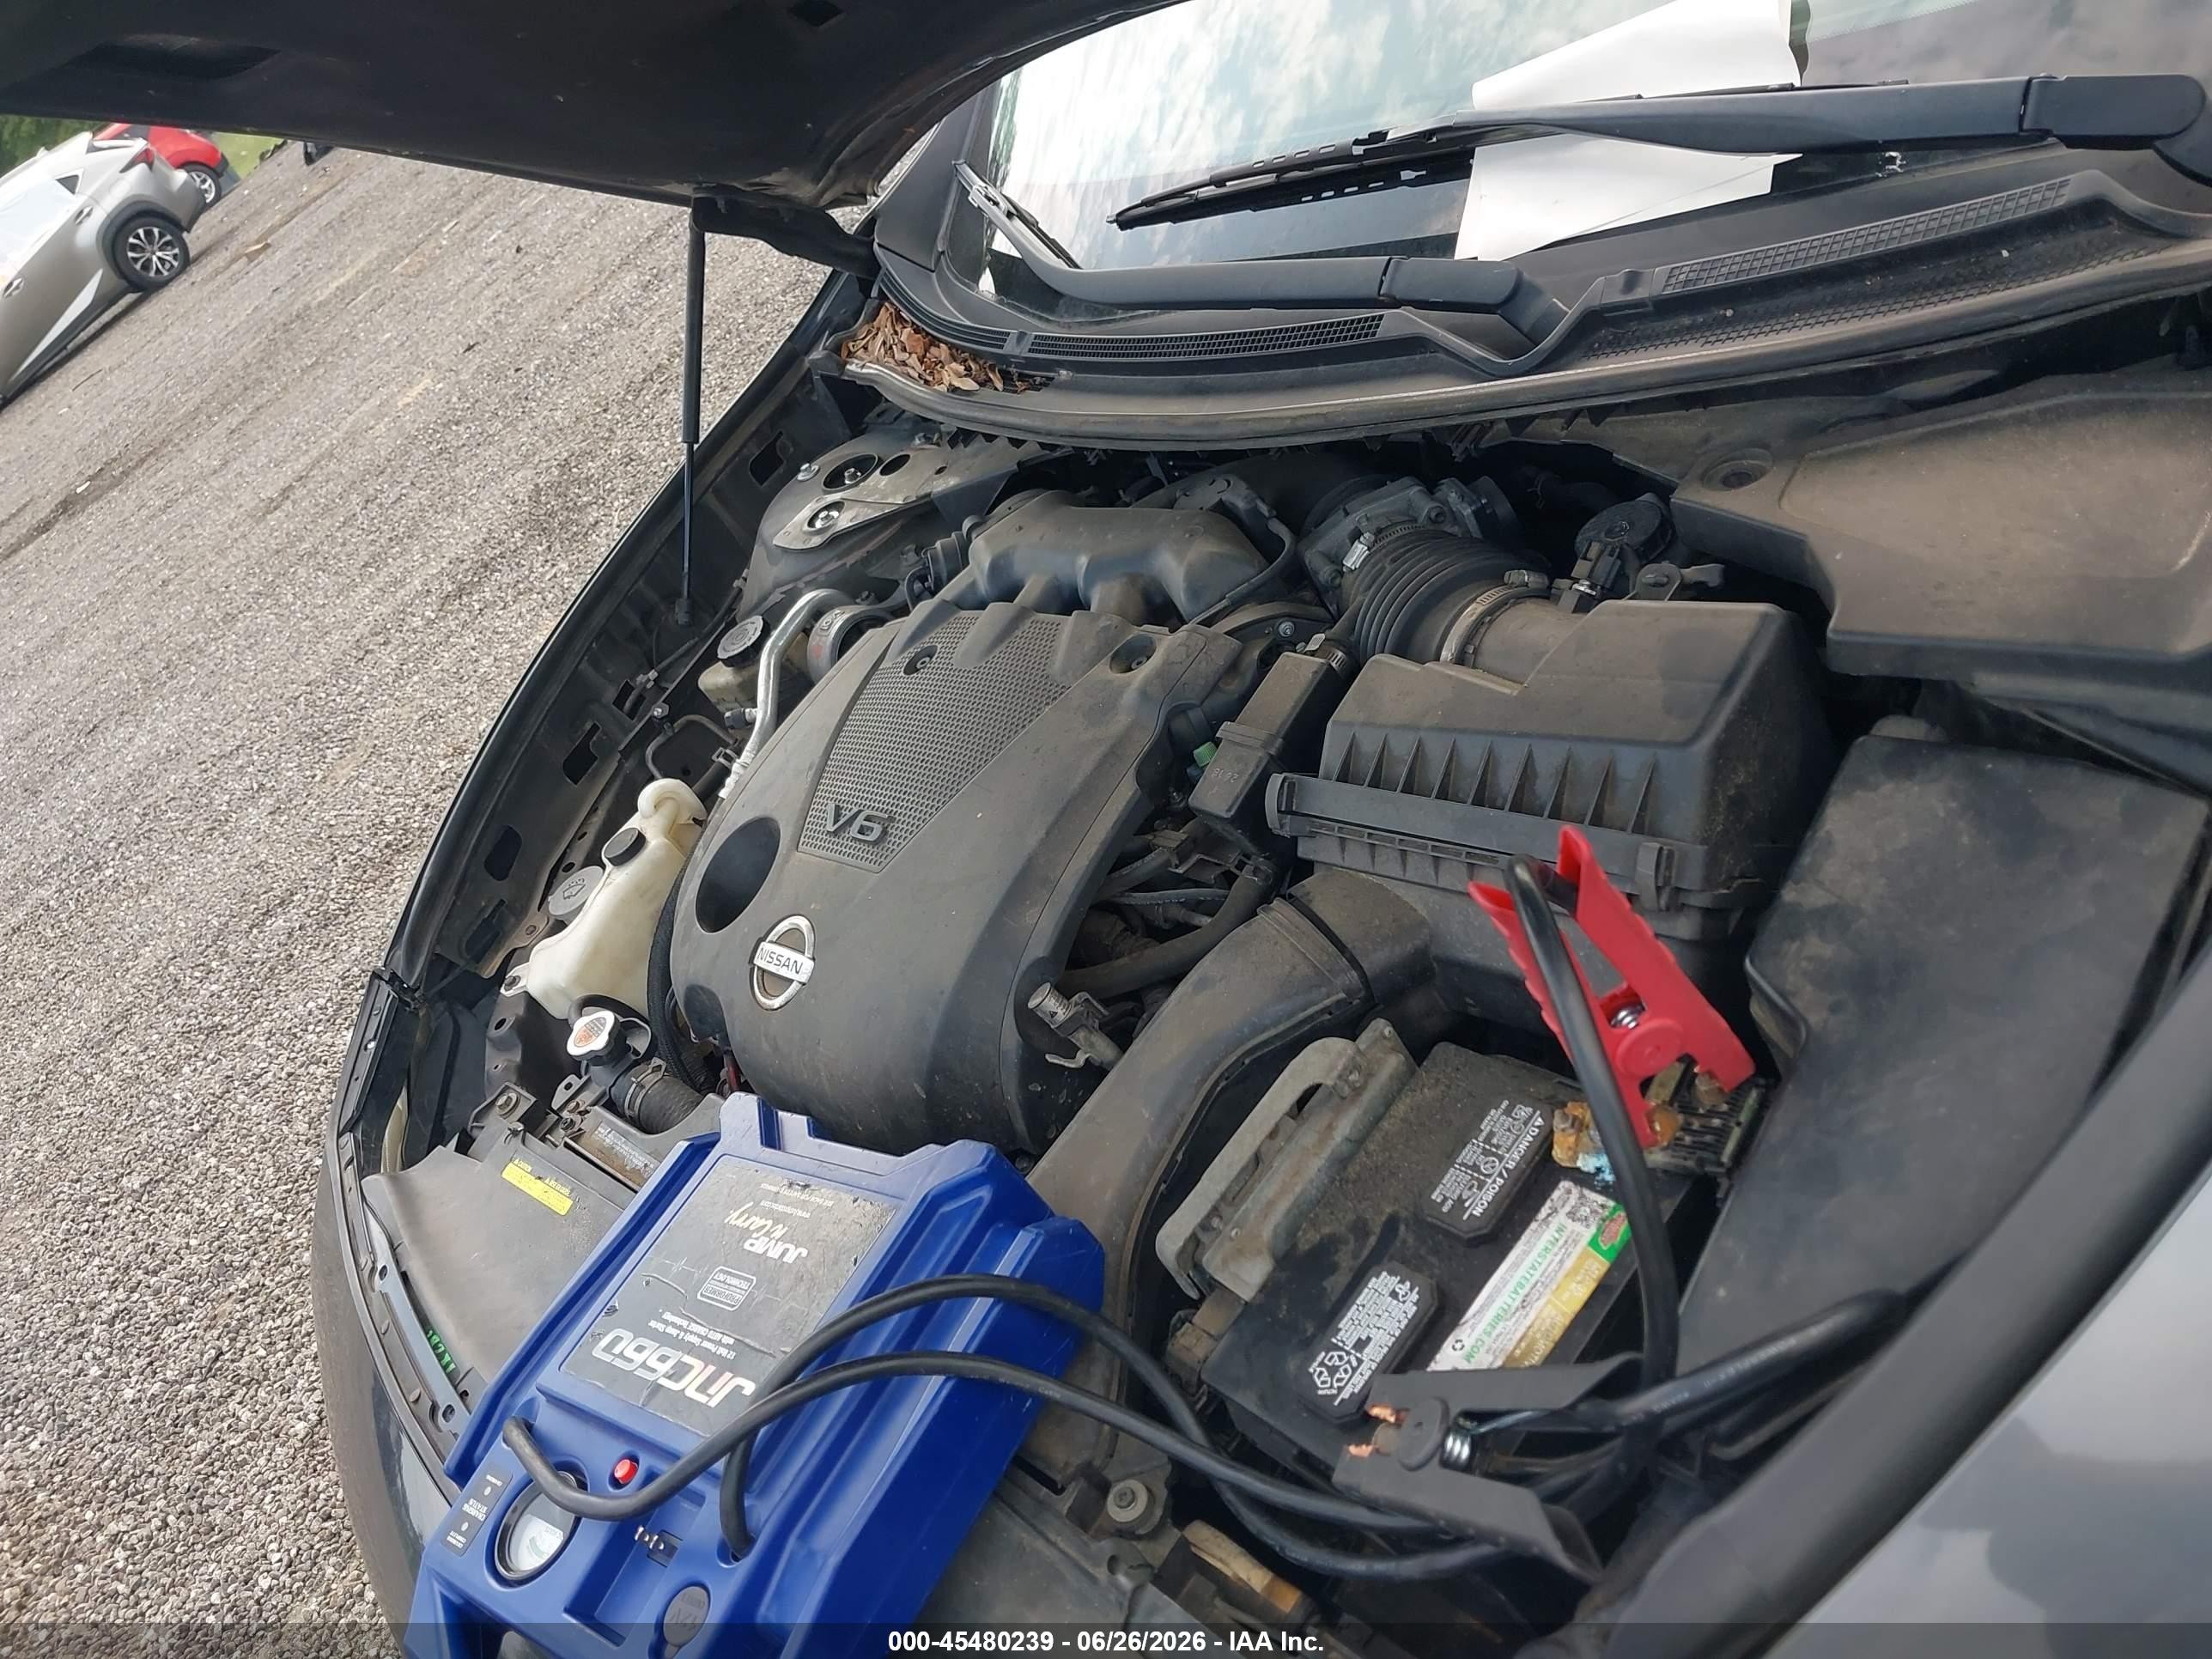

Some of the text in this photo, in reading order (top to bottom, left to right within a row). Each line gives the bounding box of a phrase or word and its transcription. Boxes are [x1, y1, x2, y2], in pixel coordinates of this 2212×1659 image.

[826, 803, 893, 846] V6
[757, 945, 804, 975] NISSAN
[1504, 1125, 1538, 1169] DANGER
[1472, 1176, 1504, 1217] POISON
[744, 1236, 809, 1264] JUMP
[1464, 1222, 1567, 1364] INTERSTATEBATTERIES.COM
